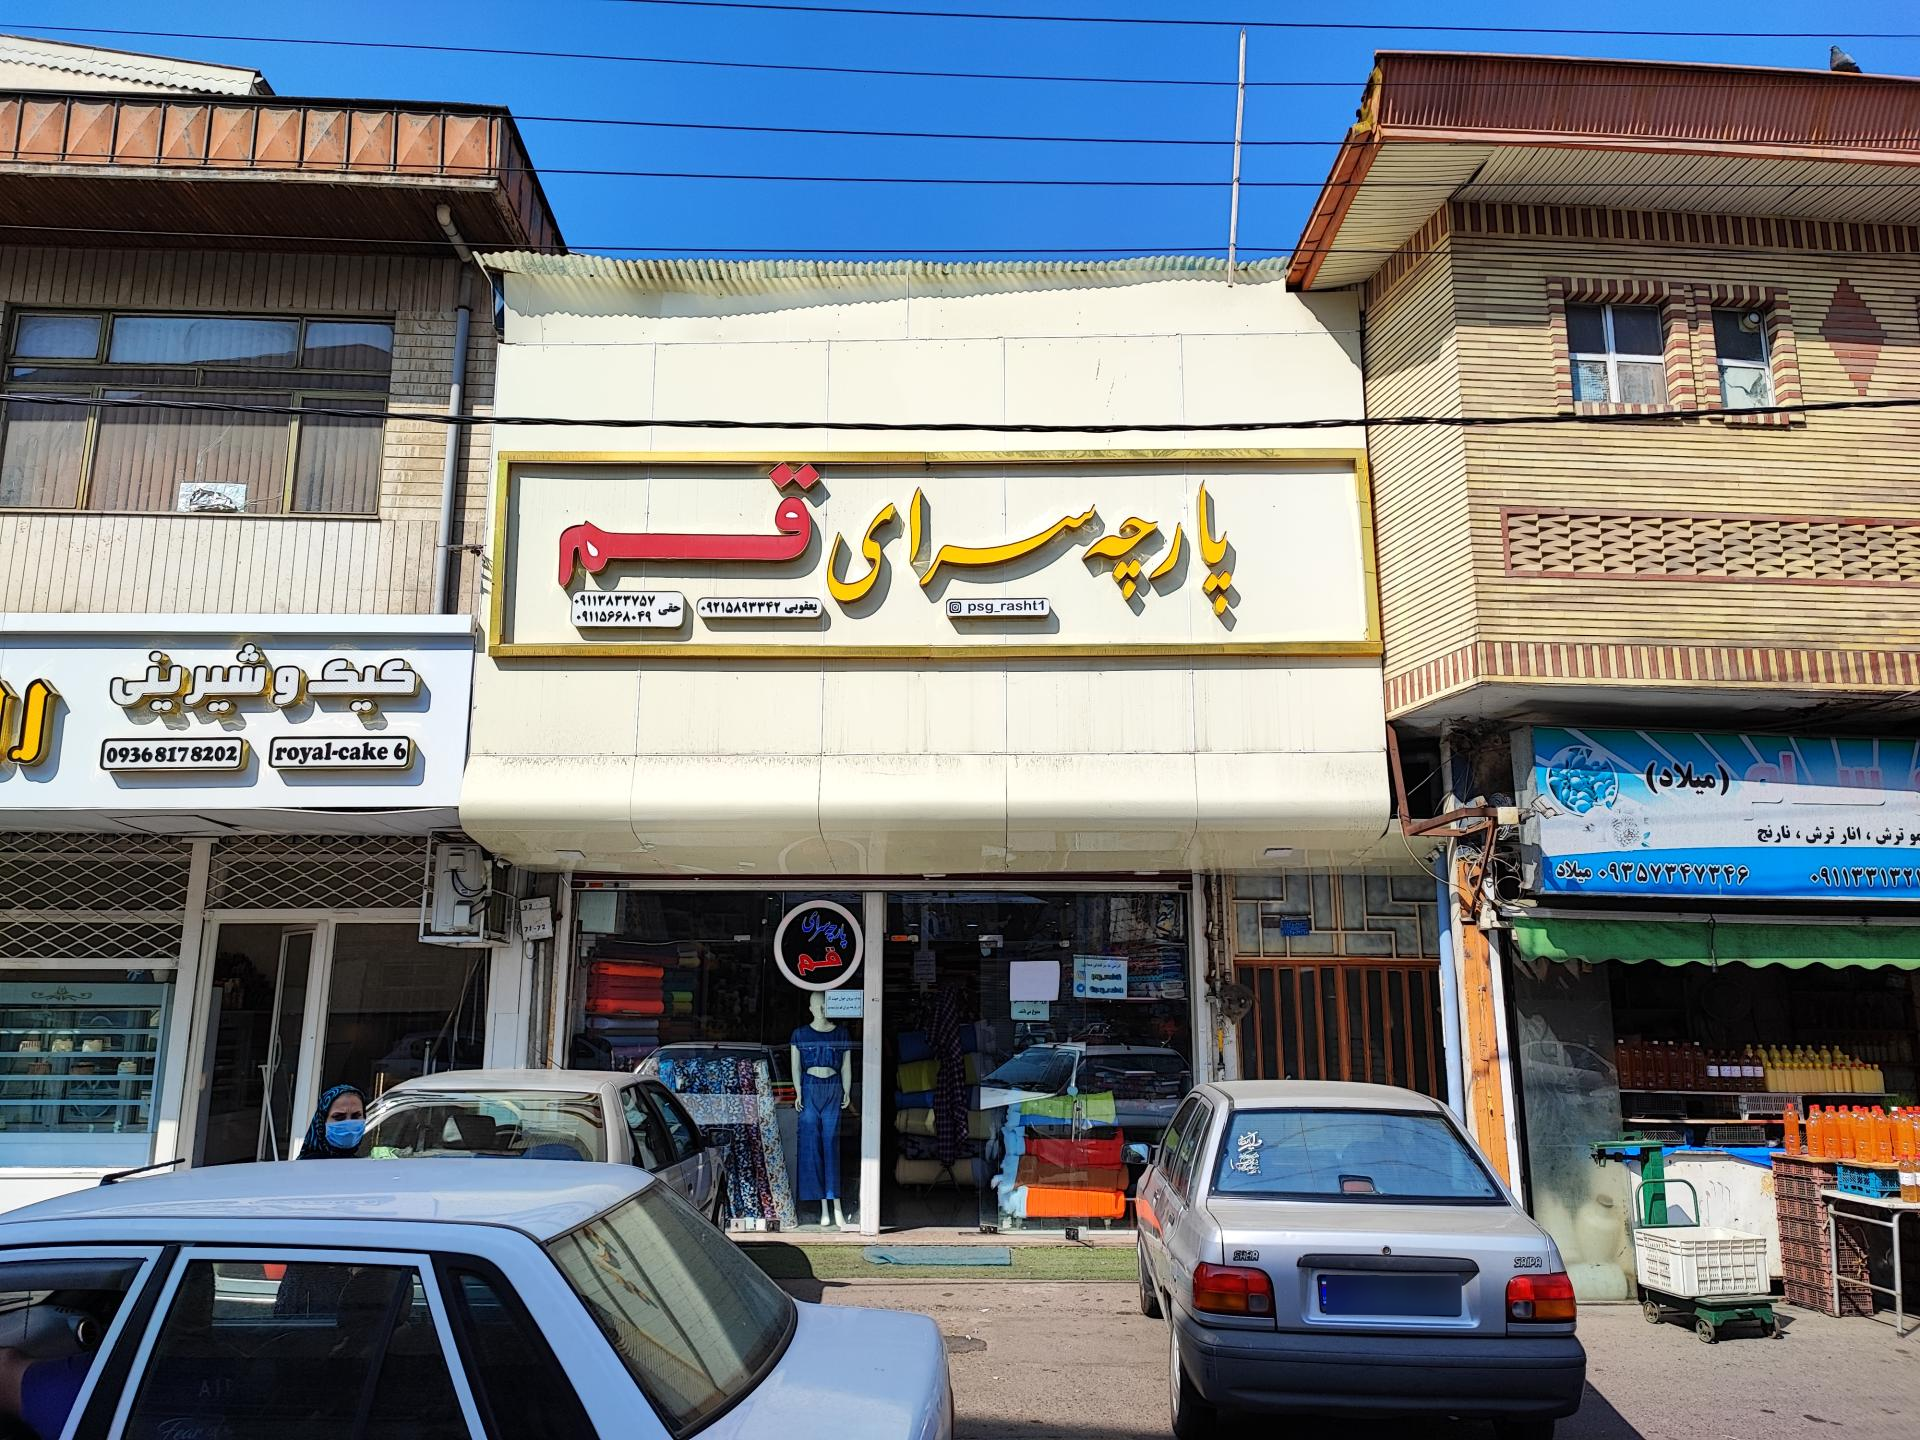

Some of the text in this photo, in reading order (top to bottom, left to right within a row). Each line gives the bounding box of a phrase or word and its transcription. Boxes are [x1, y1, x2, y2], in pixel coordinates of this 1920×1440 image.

[558, 462, 820, 588] قم
[784, 601, 818, 614] یعقوبی
[967, 600, 1045, 614] psg_rasht1
[110, 642, 420, 713] کیک و شیرینی
[106, 745, 239, 765] 09368178202
[273, 741, 407, 767] royal-cake 6
[1645, 760, 1730, 797] (میلاد)
[1757, 825, 1791, 843] نارنج
[1805, 826, 1835, 844] ترش
[1840, 826, 1862, 845] انار
[1876, 827, 1904, 846] ترش
[1555, 859, 1594, 884] میلاد
[797, 946, 843, 976] قم
[1513, 1256, 1543, 1269] SAIPA
